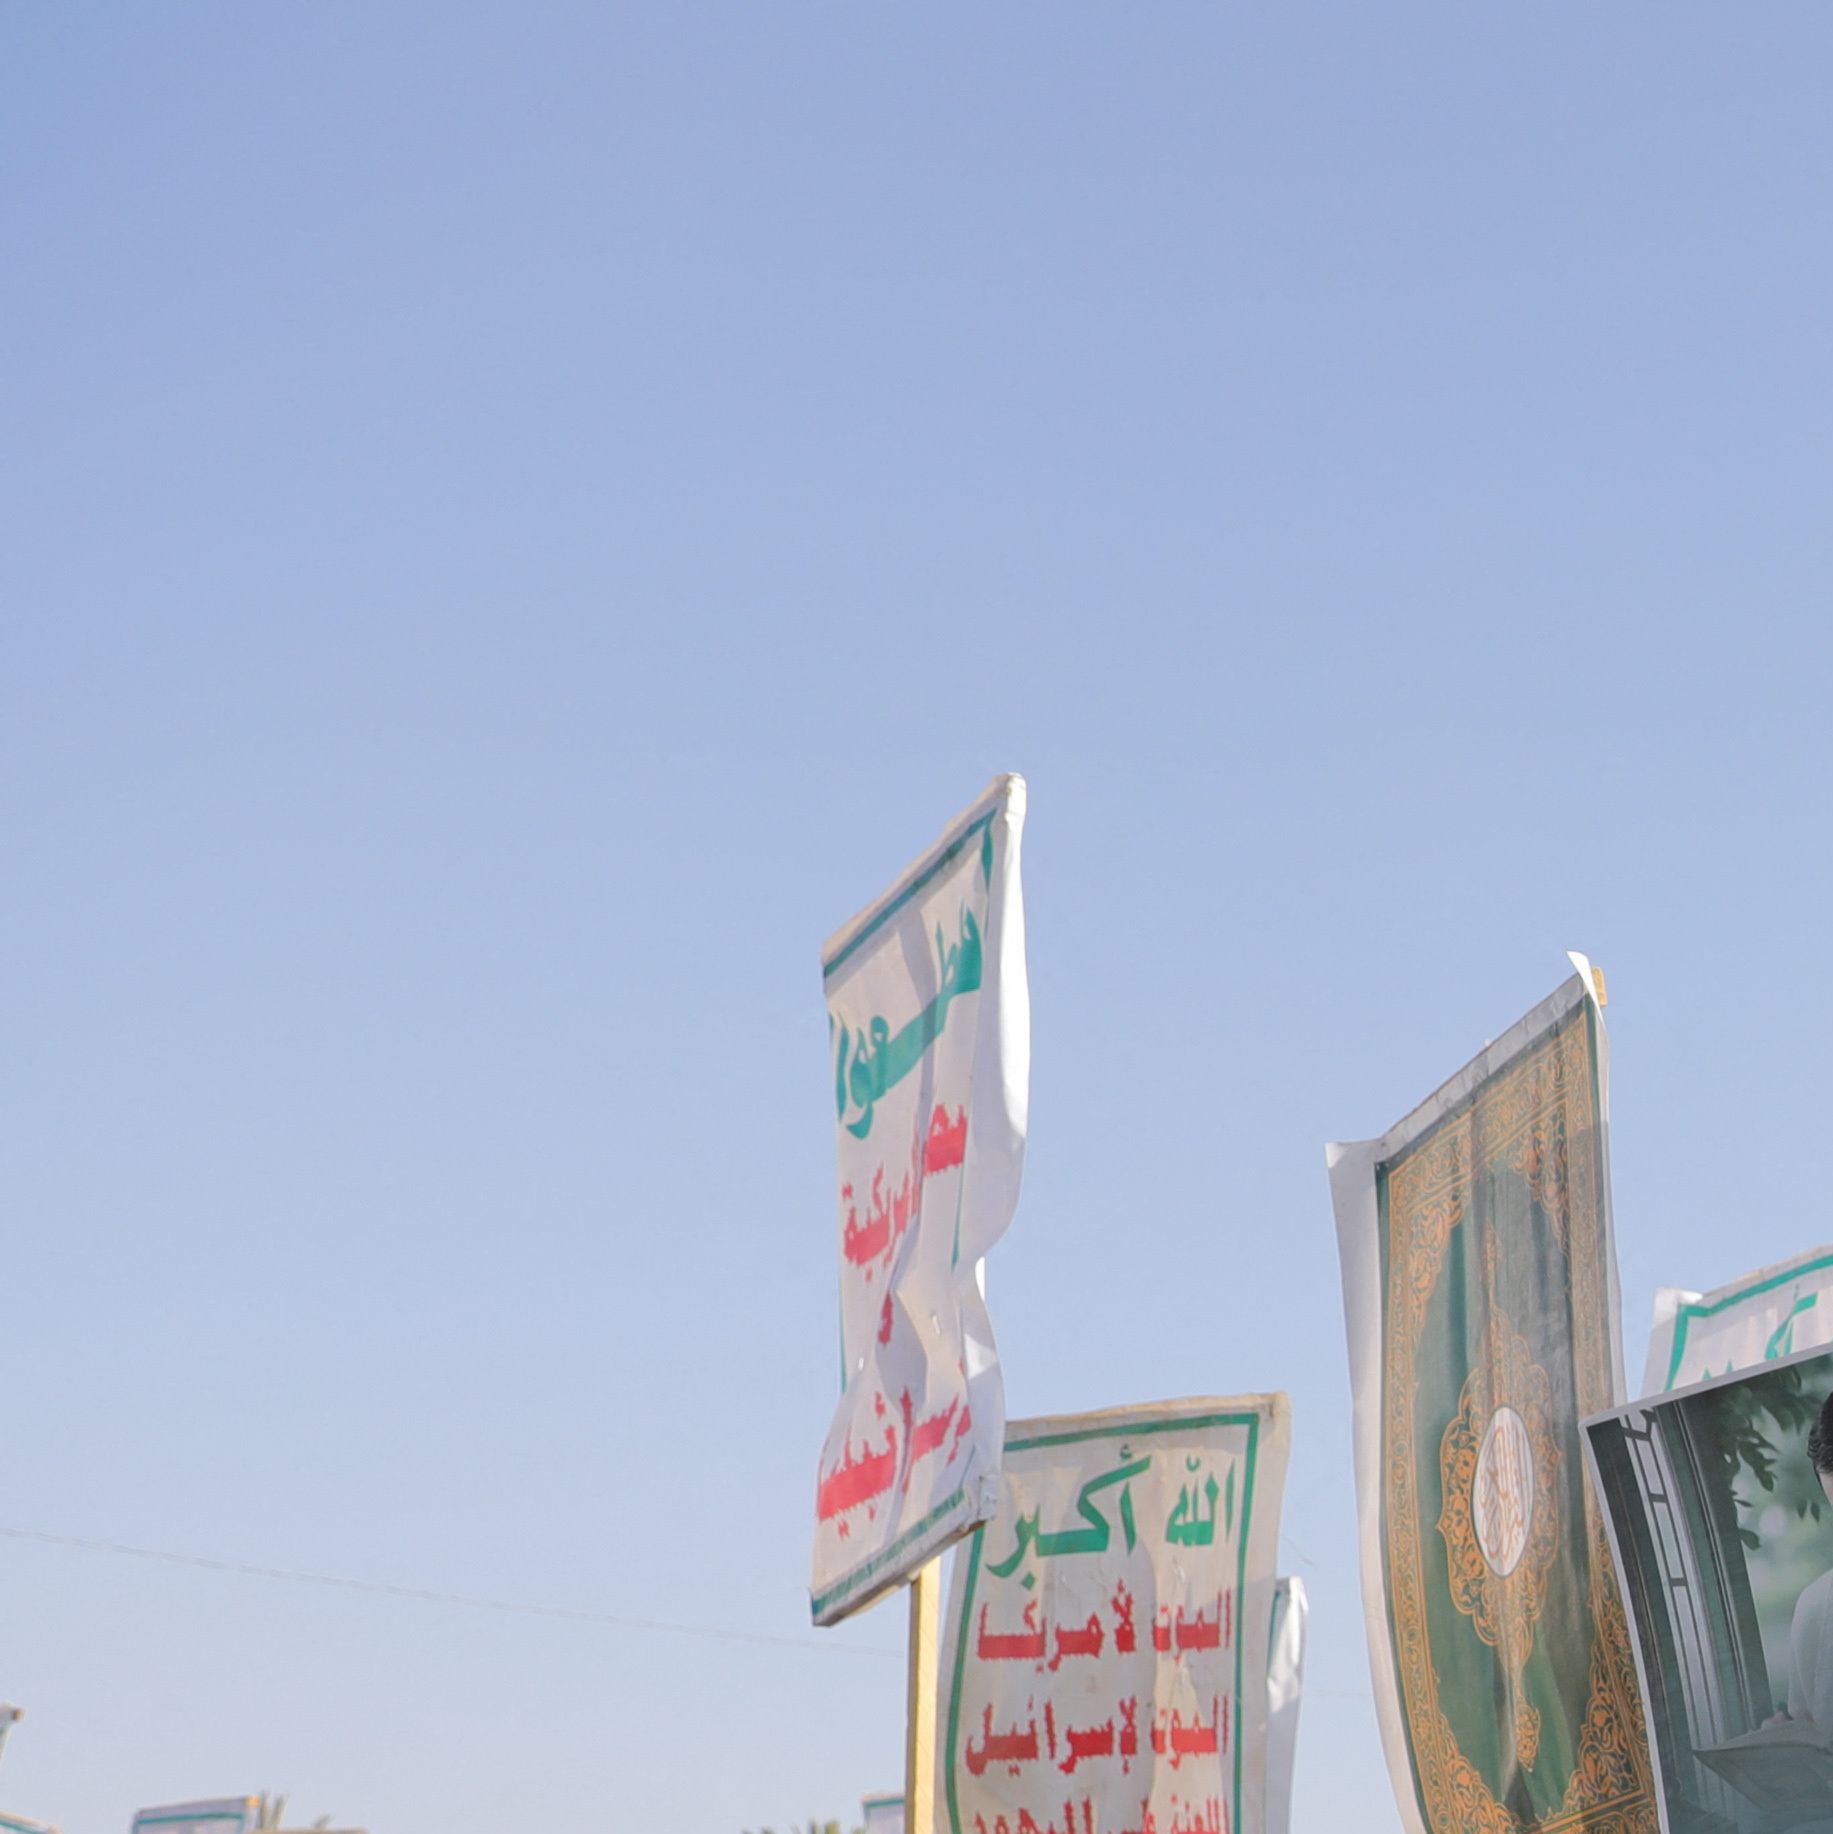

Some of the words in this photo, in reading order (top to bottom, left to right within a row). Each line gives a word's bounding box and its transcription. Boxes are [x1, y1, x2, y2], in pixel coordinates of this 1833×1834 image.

[985, 1444, 1152, 1590] أكبر
[1165, 1455, 1236, 1548] الله
[976, 1578, 1138, 1672] لأمريكا
[1152, 1588, 1231, 1664] الموت
[965, 1695, 1138, 1775] لإسرائيل
[1150, 1695, 1229, 1771] الموت
